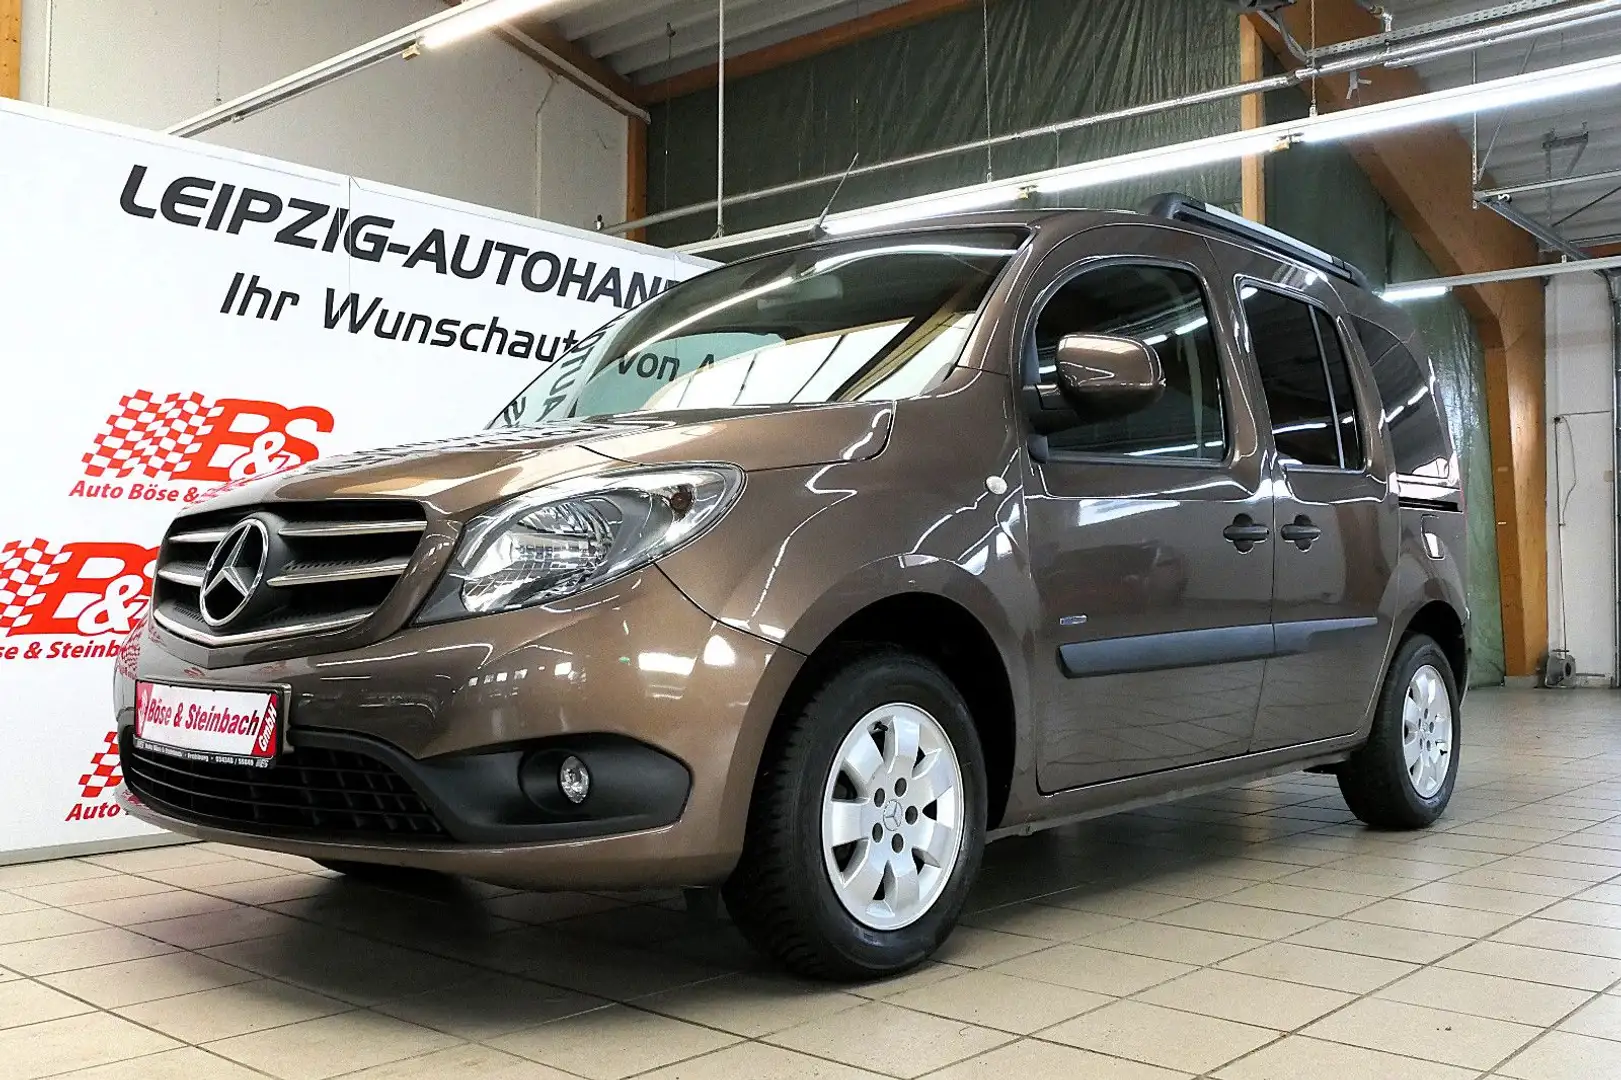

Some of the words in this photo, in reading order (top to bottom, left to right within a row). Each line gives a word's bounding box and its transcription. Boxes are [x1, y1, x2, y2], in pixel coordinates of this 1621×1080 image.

[119, 164, 683, 310] LEIPZIG-AUTOHAN
[219, 272, 300, 321] Ihr
[323, 287, 579, 362] Wunschaut
[618, 351, 680, 381] von
[68, 480, 124, 499] Auto
[127, 482, 180, 502] Böse
[182, 486, 200, 503] &
[23, 641, 43, 660] &
[45, 640, 121, 659] Steinb
[147, 698, 173, 726] Böse
[173, 702, 184, 728] &
[185, 703, 260, 736] Steinbach
[258, 702, 277, 752] GmbH
[65, 801, 121, 821] Auto
